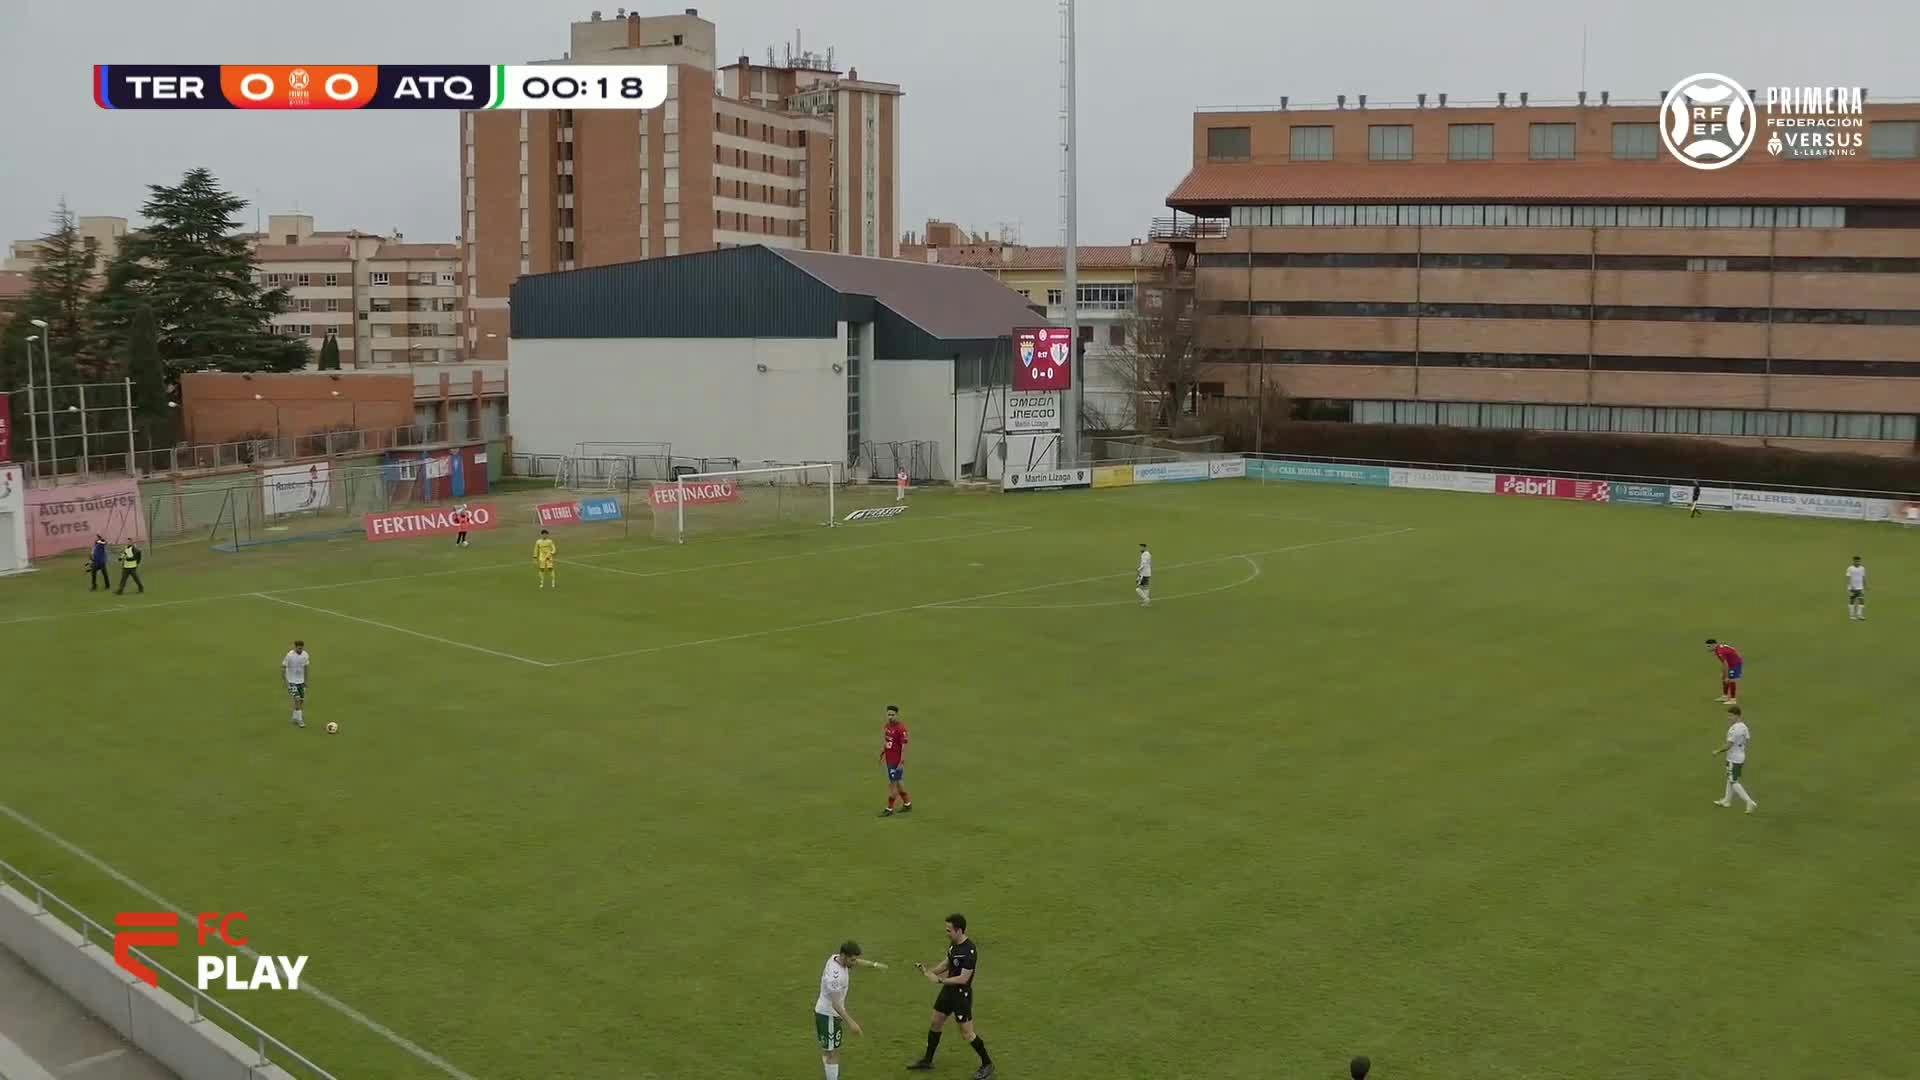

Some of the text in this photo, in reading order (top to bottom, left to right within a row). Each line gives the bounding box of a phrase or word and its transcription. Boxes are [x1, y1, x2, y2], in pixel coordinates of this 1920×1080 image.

[1032, 367, 1038, 379] 0
[1047, 367, 1053, 379] 0
[1515, 478, 1556, 496] abril
[40, 503, 75, 517] Auto
[41, 519, 90, 537] Torres
